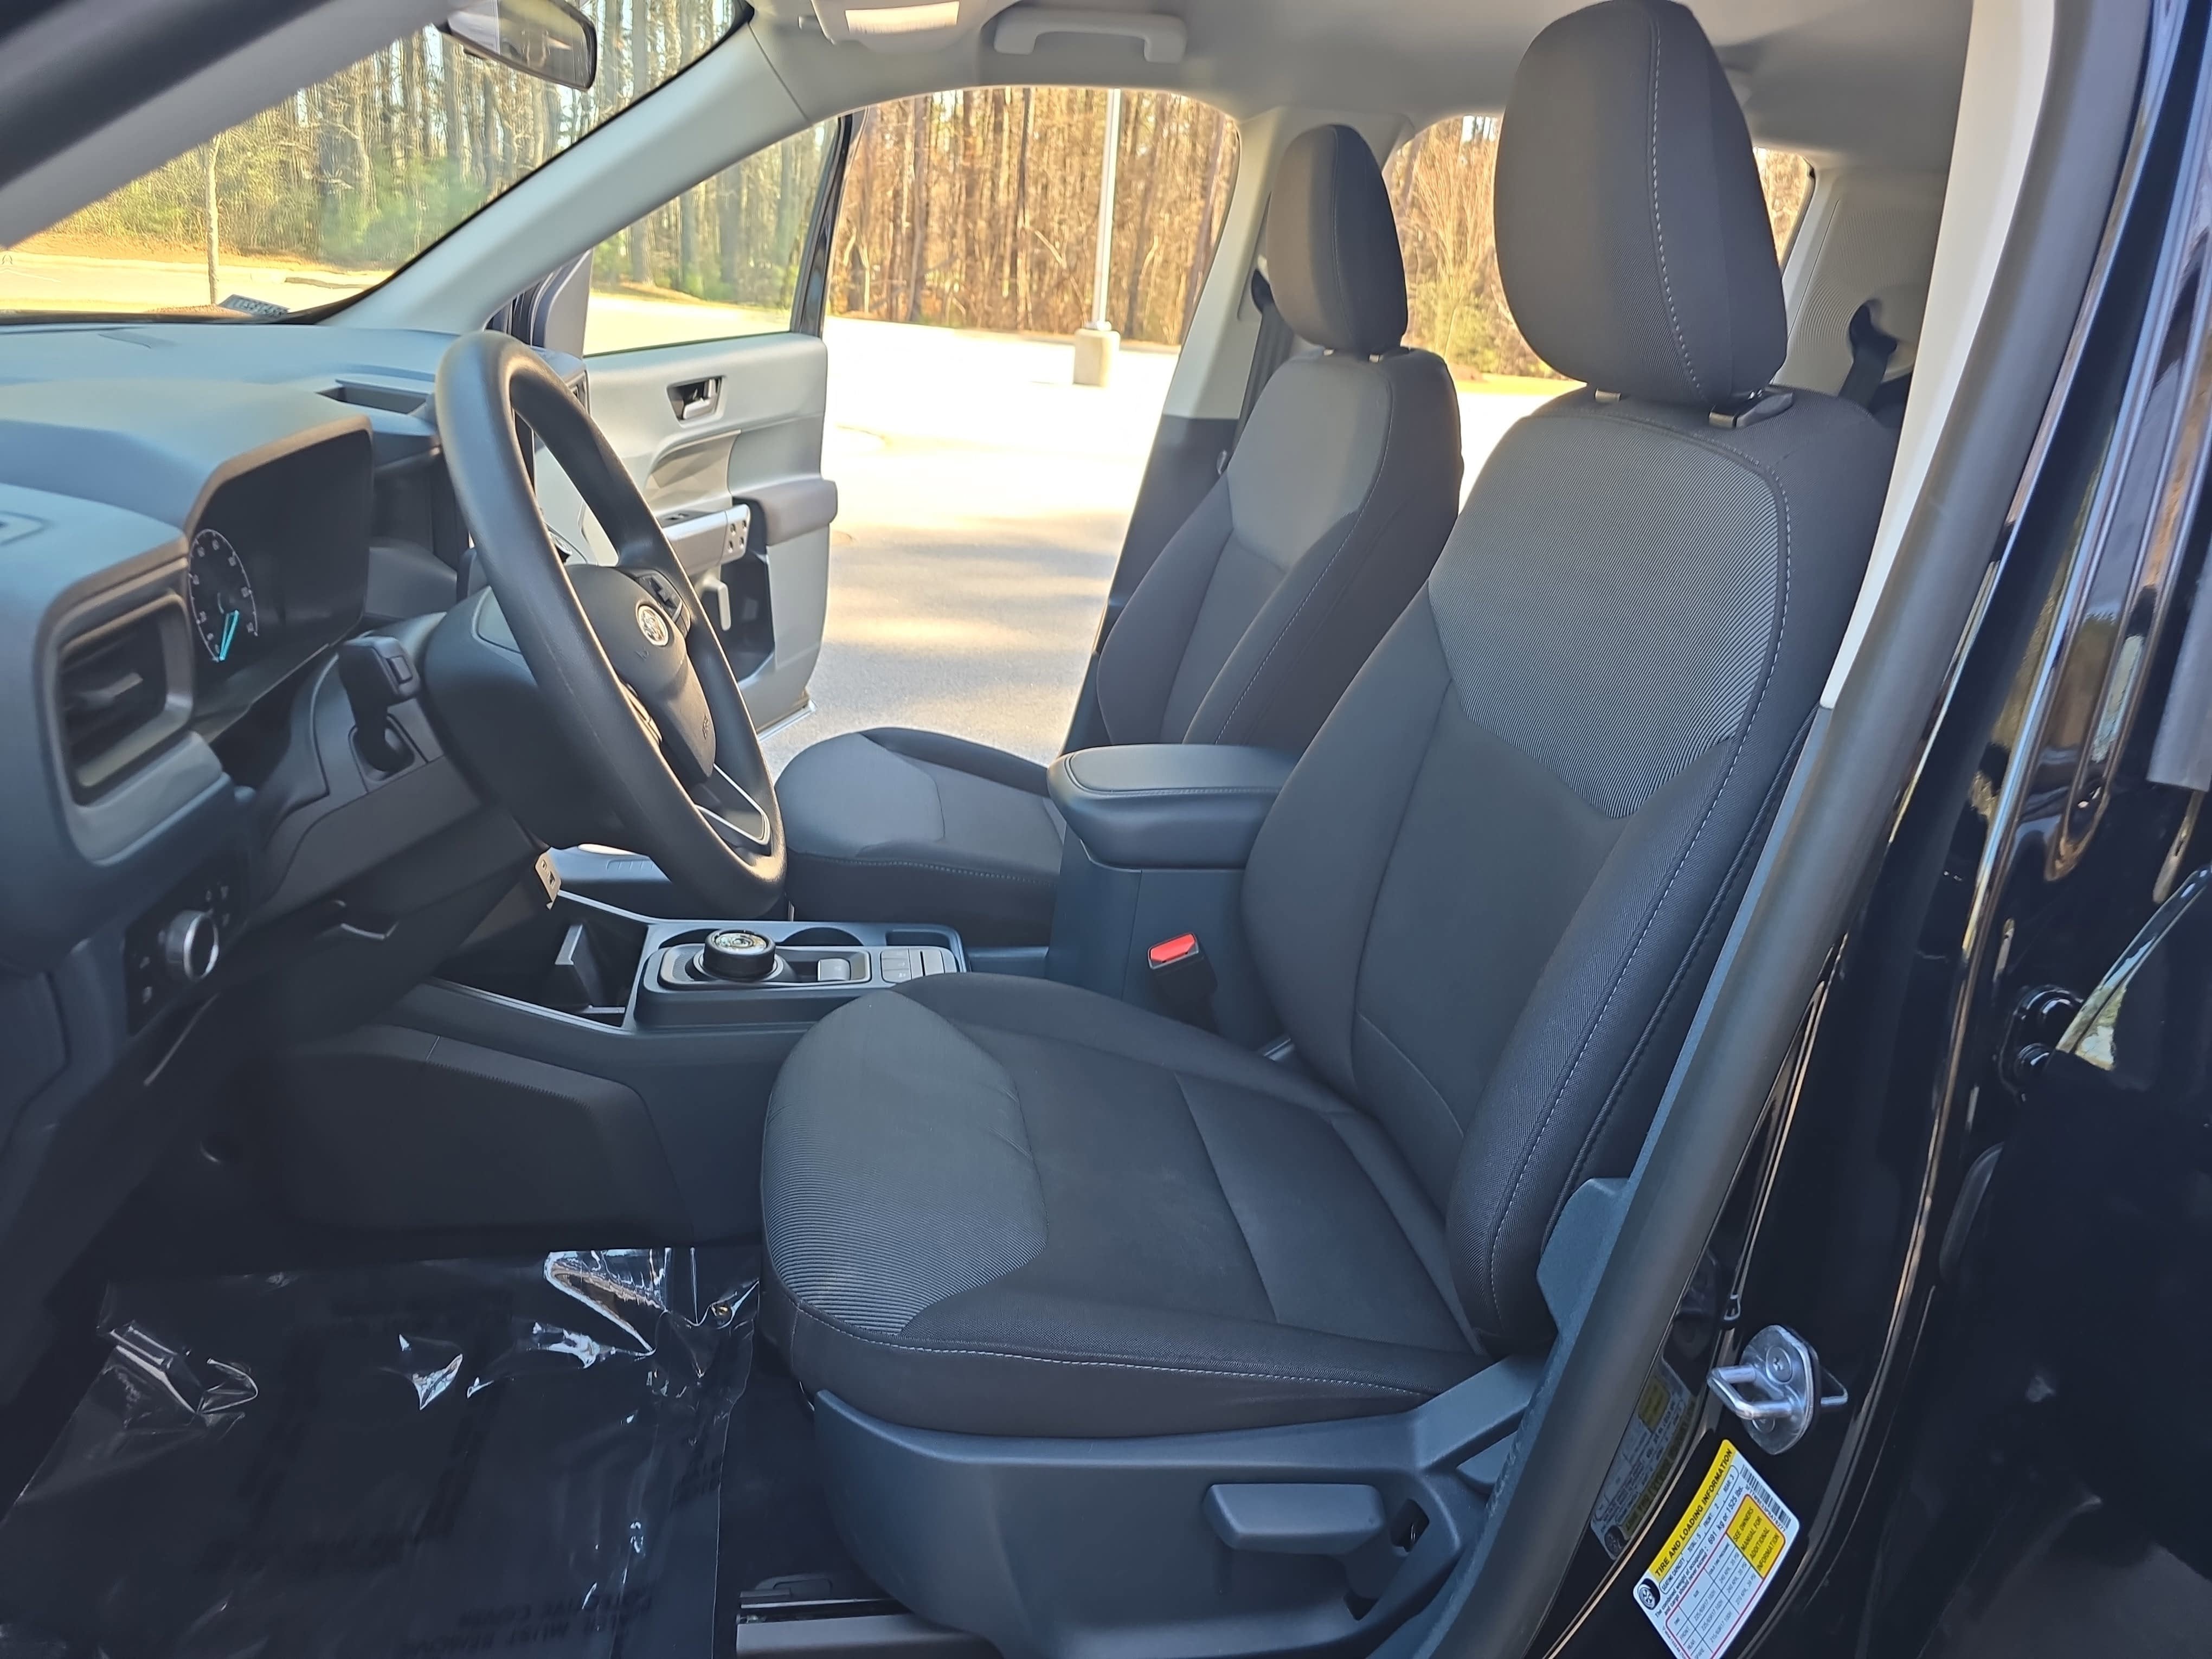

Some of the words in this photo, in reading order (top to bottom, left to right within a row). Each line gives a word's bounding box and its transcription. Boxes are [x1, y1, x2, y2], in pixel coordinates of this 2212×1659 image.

[1654, 1556, 1670, 1577] TIRE
[1668, 1539, 1681, 1559] AND
[1680, 1503, 1703, 1541] LOADING
[1701, 1448, 1732, 1506] INFORMATION
[1707, 1530, 1717, 1545] 691
[1715, 1519, 1725, 1532] kg
[1722, 1513, 1728, 1522] or
[1725, 1495, 1737, 1513] 1525
[1734, 1483, 1743, 1497] lbs.
[1732, 1528, 1741, 1542] SEE
[1740, 1527, 1756, 1552] MANUAL
[1753, 1515, 1762, 1529] FOR
[1748, 1526, 1770, 1560] ADDITIONAL
[1756, 1532, 1779, 1572] INFORMATION
[1661, 1573, 1674, 1591] SEATING
[1671, 1557, 1686, 1577] CAPACITY
[1669, 1593, 1680, 1607] cargo
[1678, 1579, 1689, 1595] should
[1688, 1567, 1697, 1581] never
[1654, 1608, 1662, 1618] The
[1660, 1587, 1676, 1611] combined
[1675, 1574, 1687, 1590] weight
